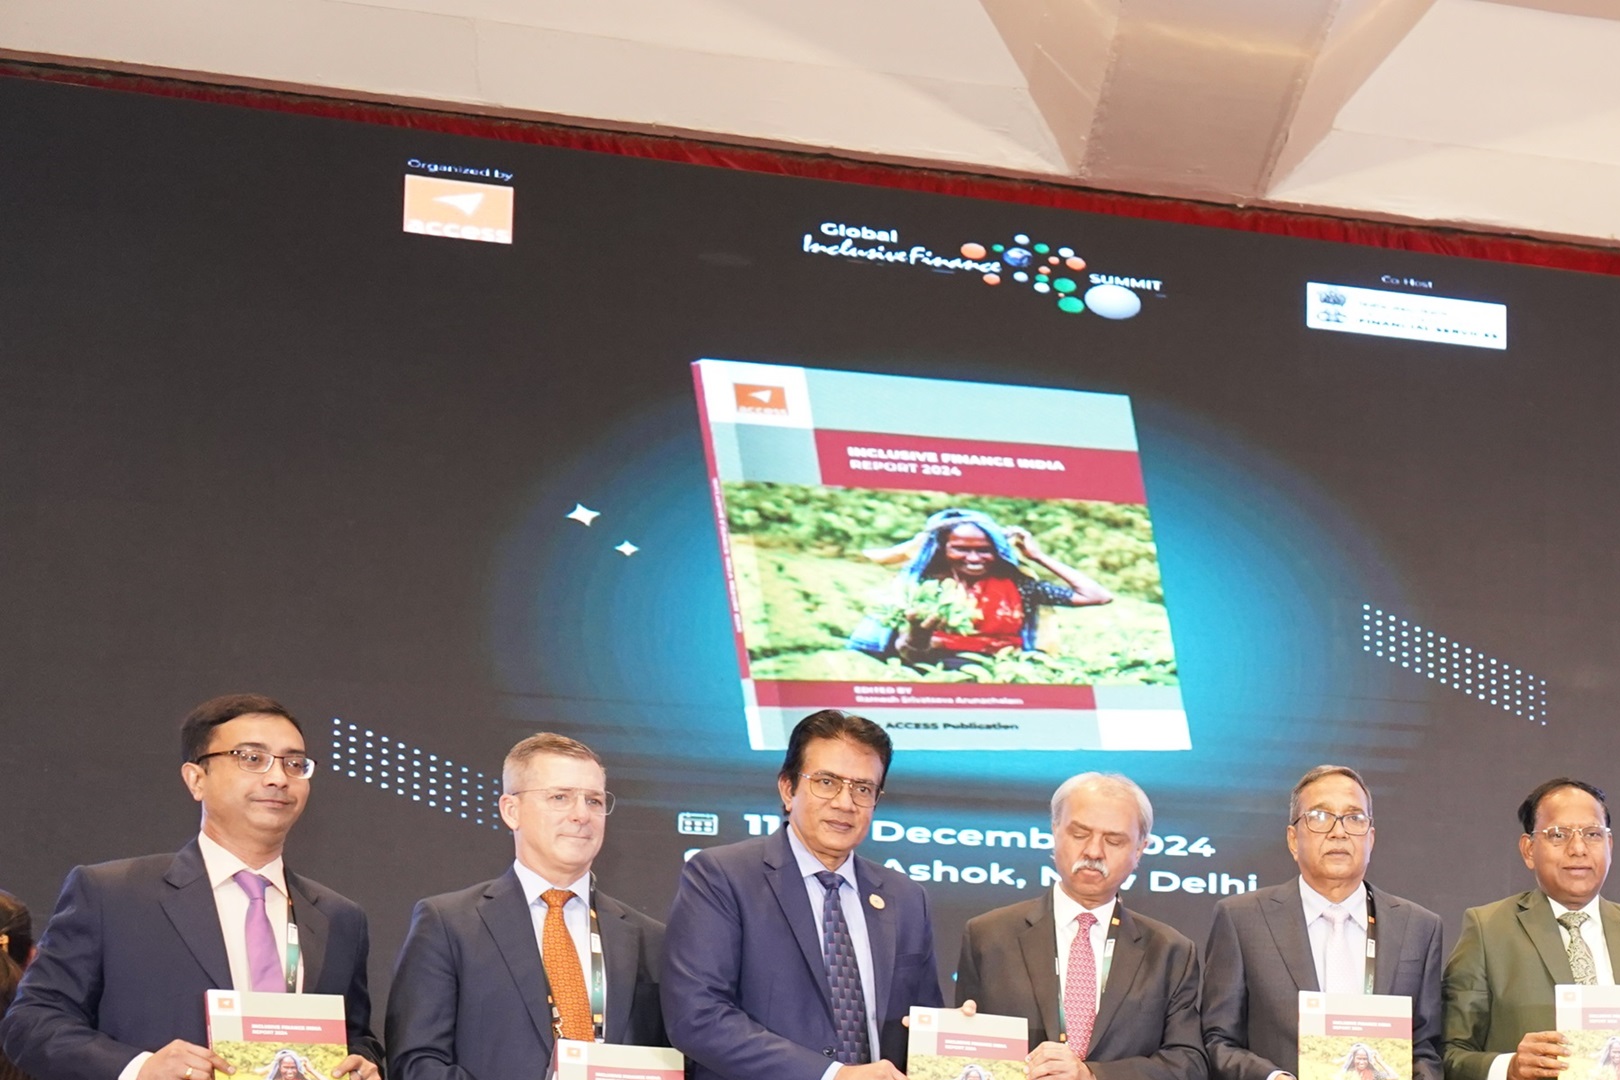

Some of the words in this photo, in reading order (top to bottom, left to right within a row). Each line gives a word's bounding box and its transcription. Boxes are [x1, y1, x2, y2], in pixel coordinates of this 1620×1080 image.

[407, 158, 490, 177] Organized
[494, 169, 513, 181] by
[405, 218, 512, 244] access
[820, 222, 898, 243] Global
[1089, 273, 1163, 292] SUMMIT
[846, 446, 939, 463] INCLUSIVE
[940, 452, 1015, 468] FINANCE
[1016, 458, 1066, 472] INDIA
[849, 459, 918, 474] REPORT
[921, 464, 962, 477] 2024
[885, 722, 939, 730] ACCESS
[943, 722, 1020, 731] Publication
[872, 820, 1054, 850] Decemb
[1143, 835, 1216, 858] 024
[1150, 870, 1258, 895] Delhi
